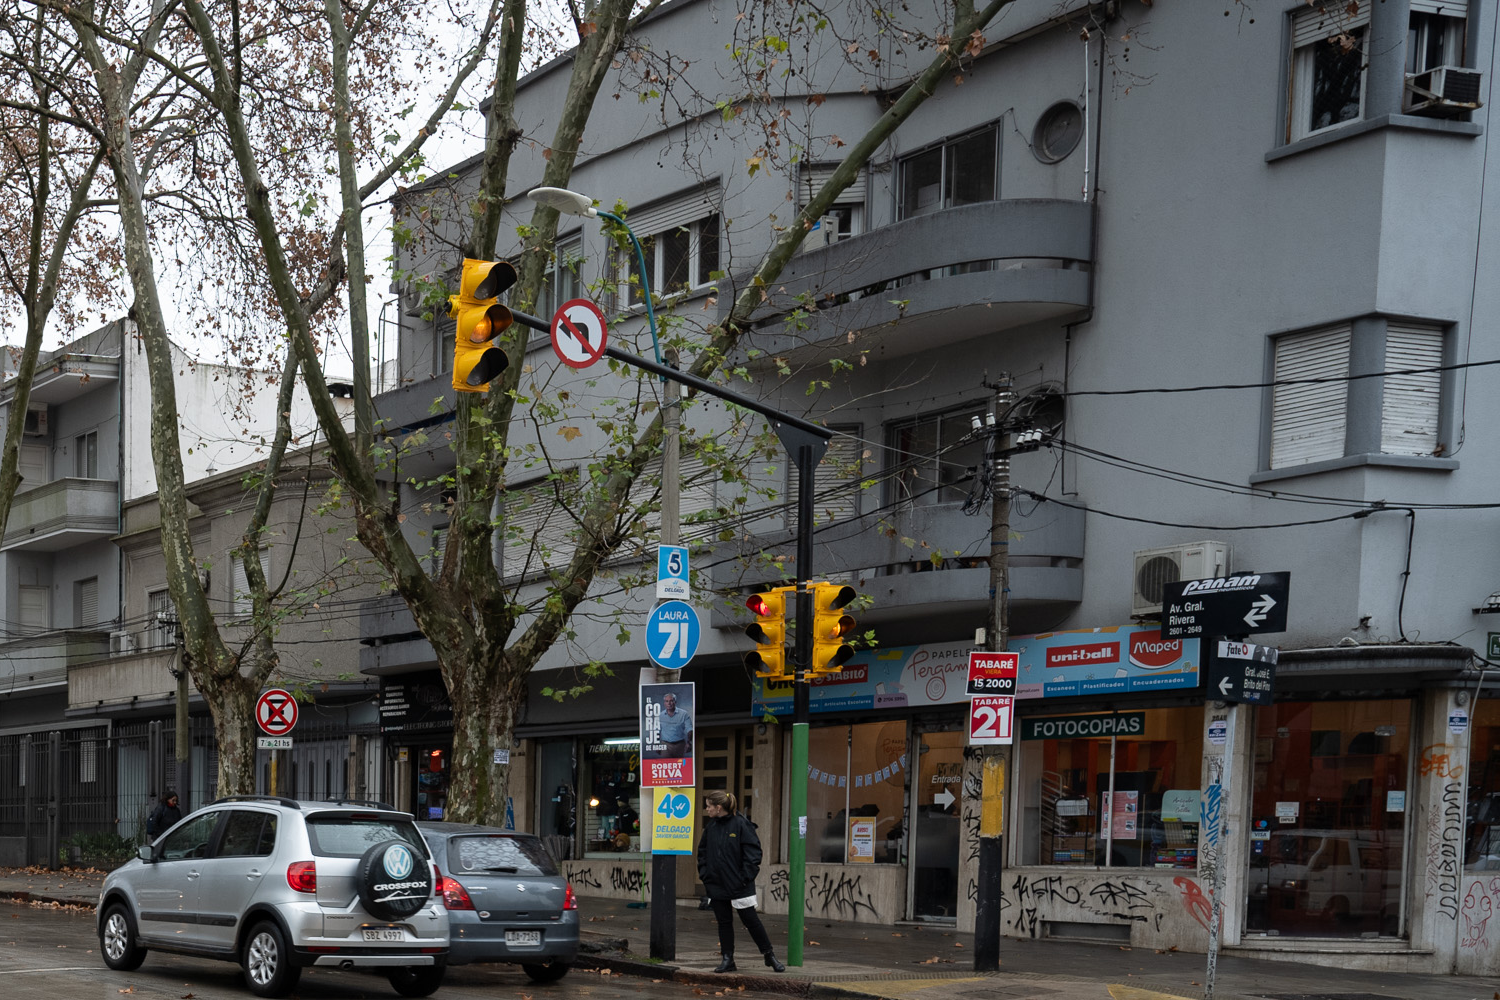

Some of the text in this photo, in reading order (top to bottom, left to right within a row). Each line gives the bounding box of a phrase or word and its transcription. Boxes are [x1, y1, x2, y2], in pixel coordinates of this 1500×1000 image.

[668, 553, 681, 575] 5
[1181, 575, 1261, 596] panam
[1169, 601, 1204, 614] Av. Gral.
[658, 611, 689, 621] LAURA
[1169, 615, 1195, 626] Rivera
[1169, 627, 1183, 635] 2601
[1187, 625, 1202, 634] 2649
[657, 622, 689, 659] 71
[1133, 638, 1179, 655] Maped
[974, 658, 1014, 669] TABARÉ
[826, 669, 865, 682] STABILO
[1245, 666, 1256, 677] Gral.
[974, 678, 1012, 688] 15 2000
[1083, 681, 1125, 689] Plastificados
[1133, 677, 1185, 686] Encuadernados
[1243, 678, 1255, 689] Brito
[1255, 680, 1263, 690] del
[1047, 684, 1076, 692] Escaneos
[975, 697, 1010, 706] TABARÉ
[645, 703, 661, 717] CO
[645, 716, 661, 731] RA
[972, 705, 1010, 738] 21
[1033, 716, 1140, 737] FOTOCOPIAS
[645, 730, 660, 744] JE
[260, 739, 265, 747] 7
[273, 739, 281, 747] 21
[282, 739, 290, 747] hs
[589, 744, 610, 753] TIENDA
[651, 762, 682, 770] ROBERT
[651, 769, 682, 778] SILVA
[931, 774, 962, 784] Entrada
[657, 793, 691, 819] 40
[656, 825, 691, 834] DELGADO
[373, 881, 428, 891] CROSSFOX
[365, 930, 402, 940] SBZ 4997
